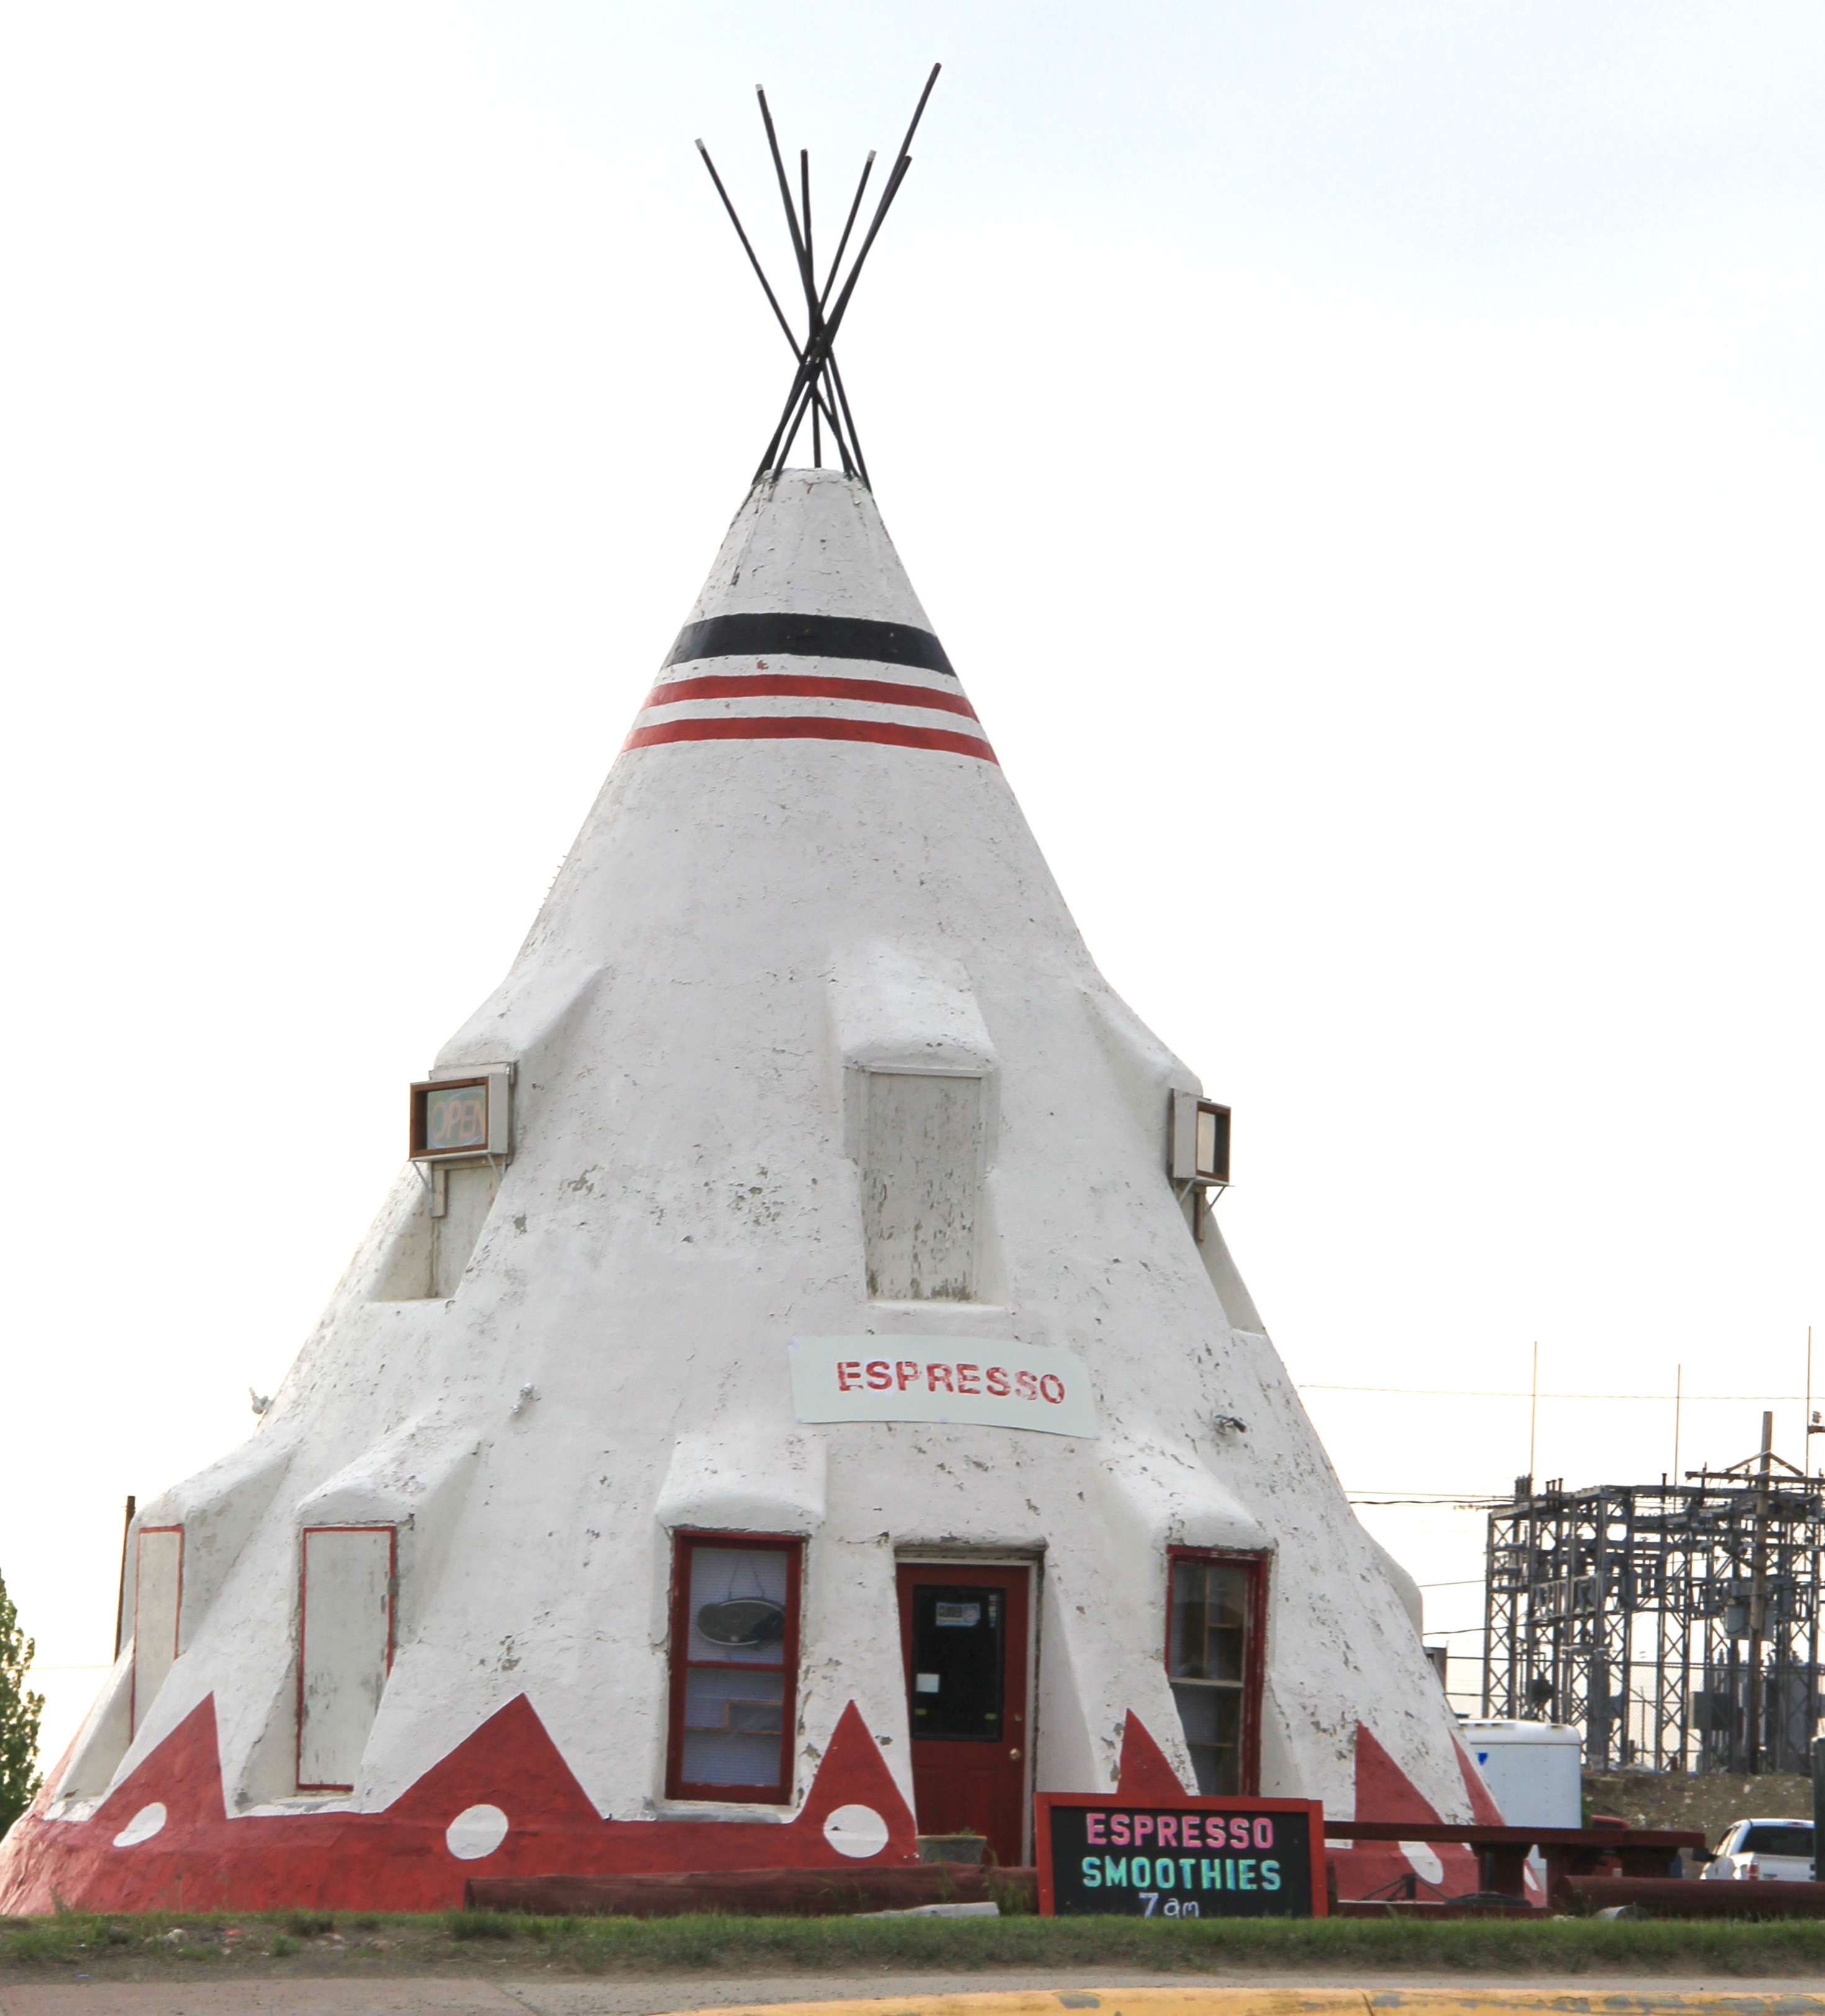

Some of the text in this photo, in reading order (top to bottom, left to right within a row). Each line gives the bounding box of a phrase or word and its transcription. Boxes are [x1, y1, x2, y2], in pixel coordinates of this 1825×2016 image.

[836, 1360, 1066, 1404] ESPRESSO
[1086, 1812, 1274, 1849] ESPRESSO
[1081, 1856, 1281, 1891] SMOOTHIES
[1139, 1892, 1199, 1918] 7 am
